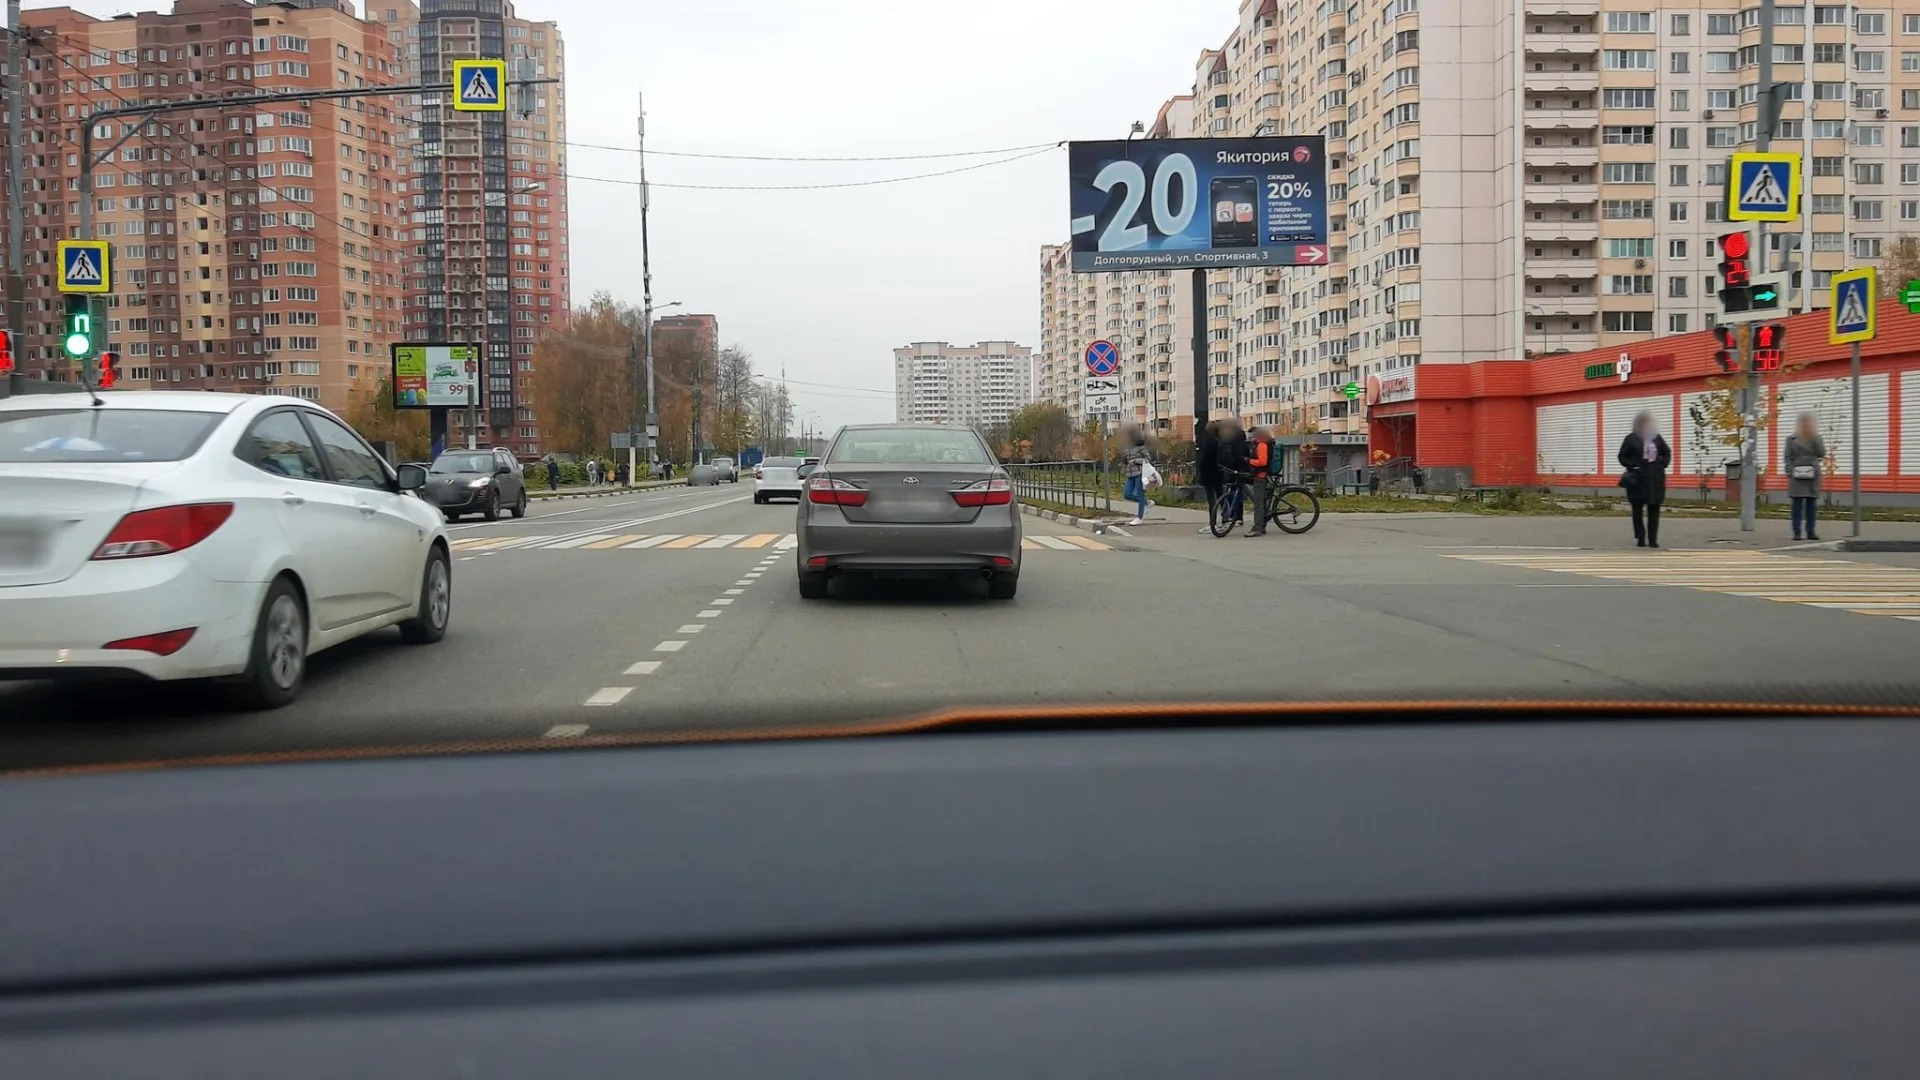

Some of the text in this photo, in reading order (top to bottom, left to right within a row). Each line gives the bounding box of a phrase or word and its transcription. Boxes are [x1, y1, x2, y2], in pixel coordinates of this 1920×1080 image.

[1216, 151, 1289, 164] Якитория
[1267, 182, 1312, 199] 20%
[1072, 152, 1198, 252] -20
[1094, 251, 1269, 266] Долгопрудный, ул. Спортивная, 3
